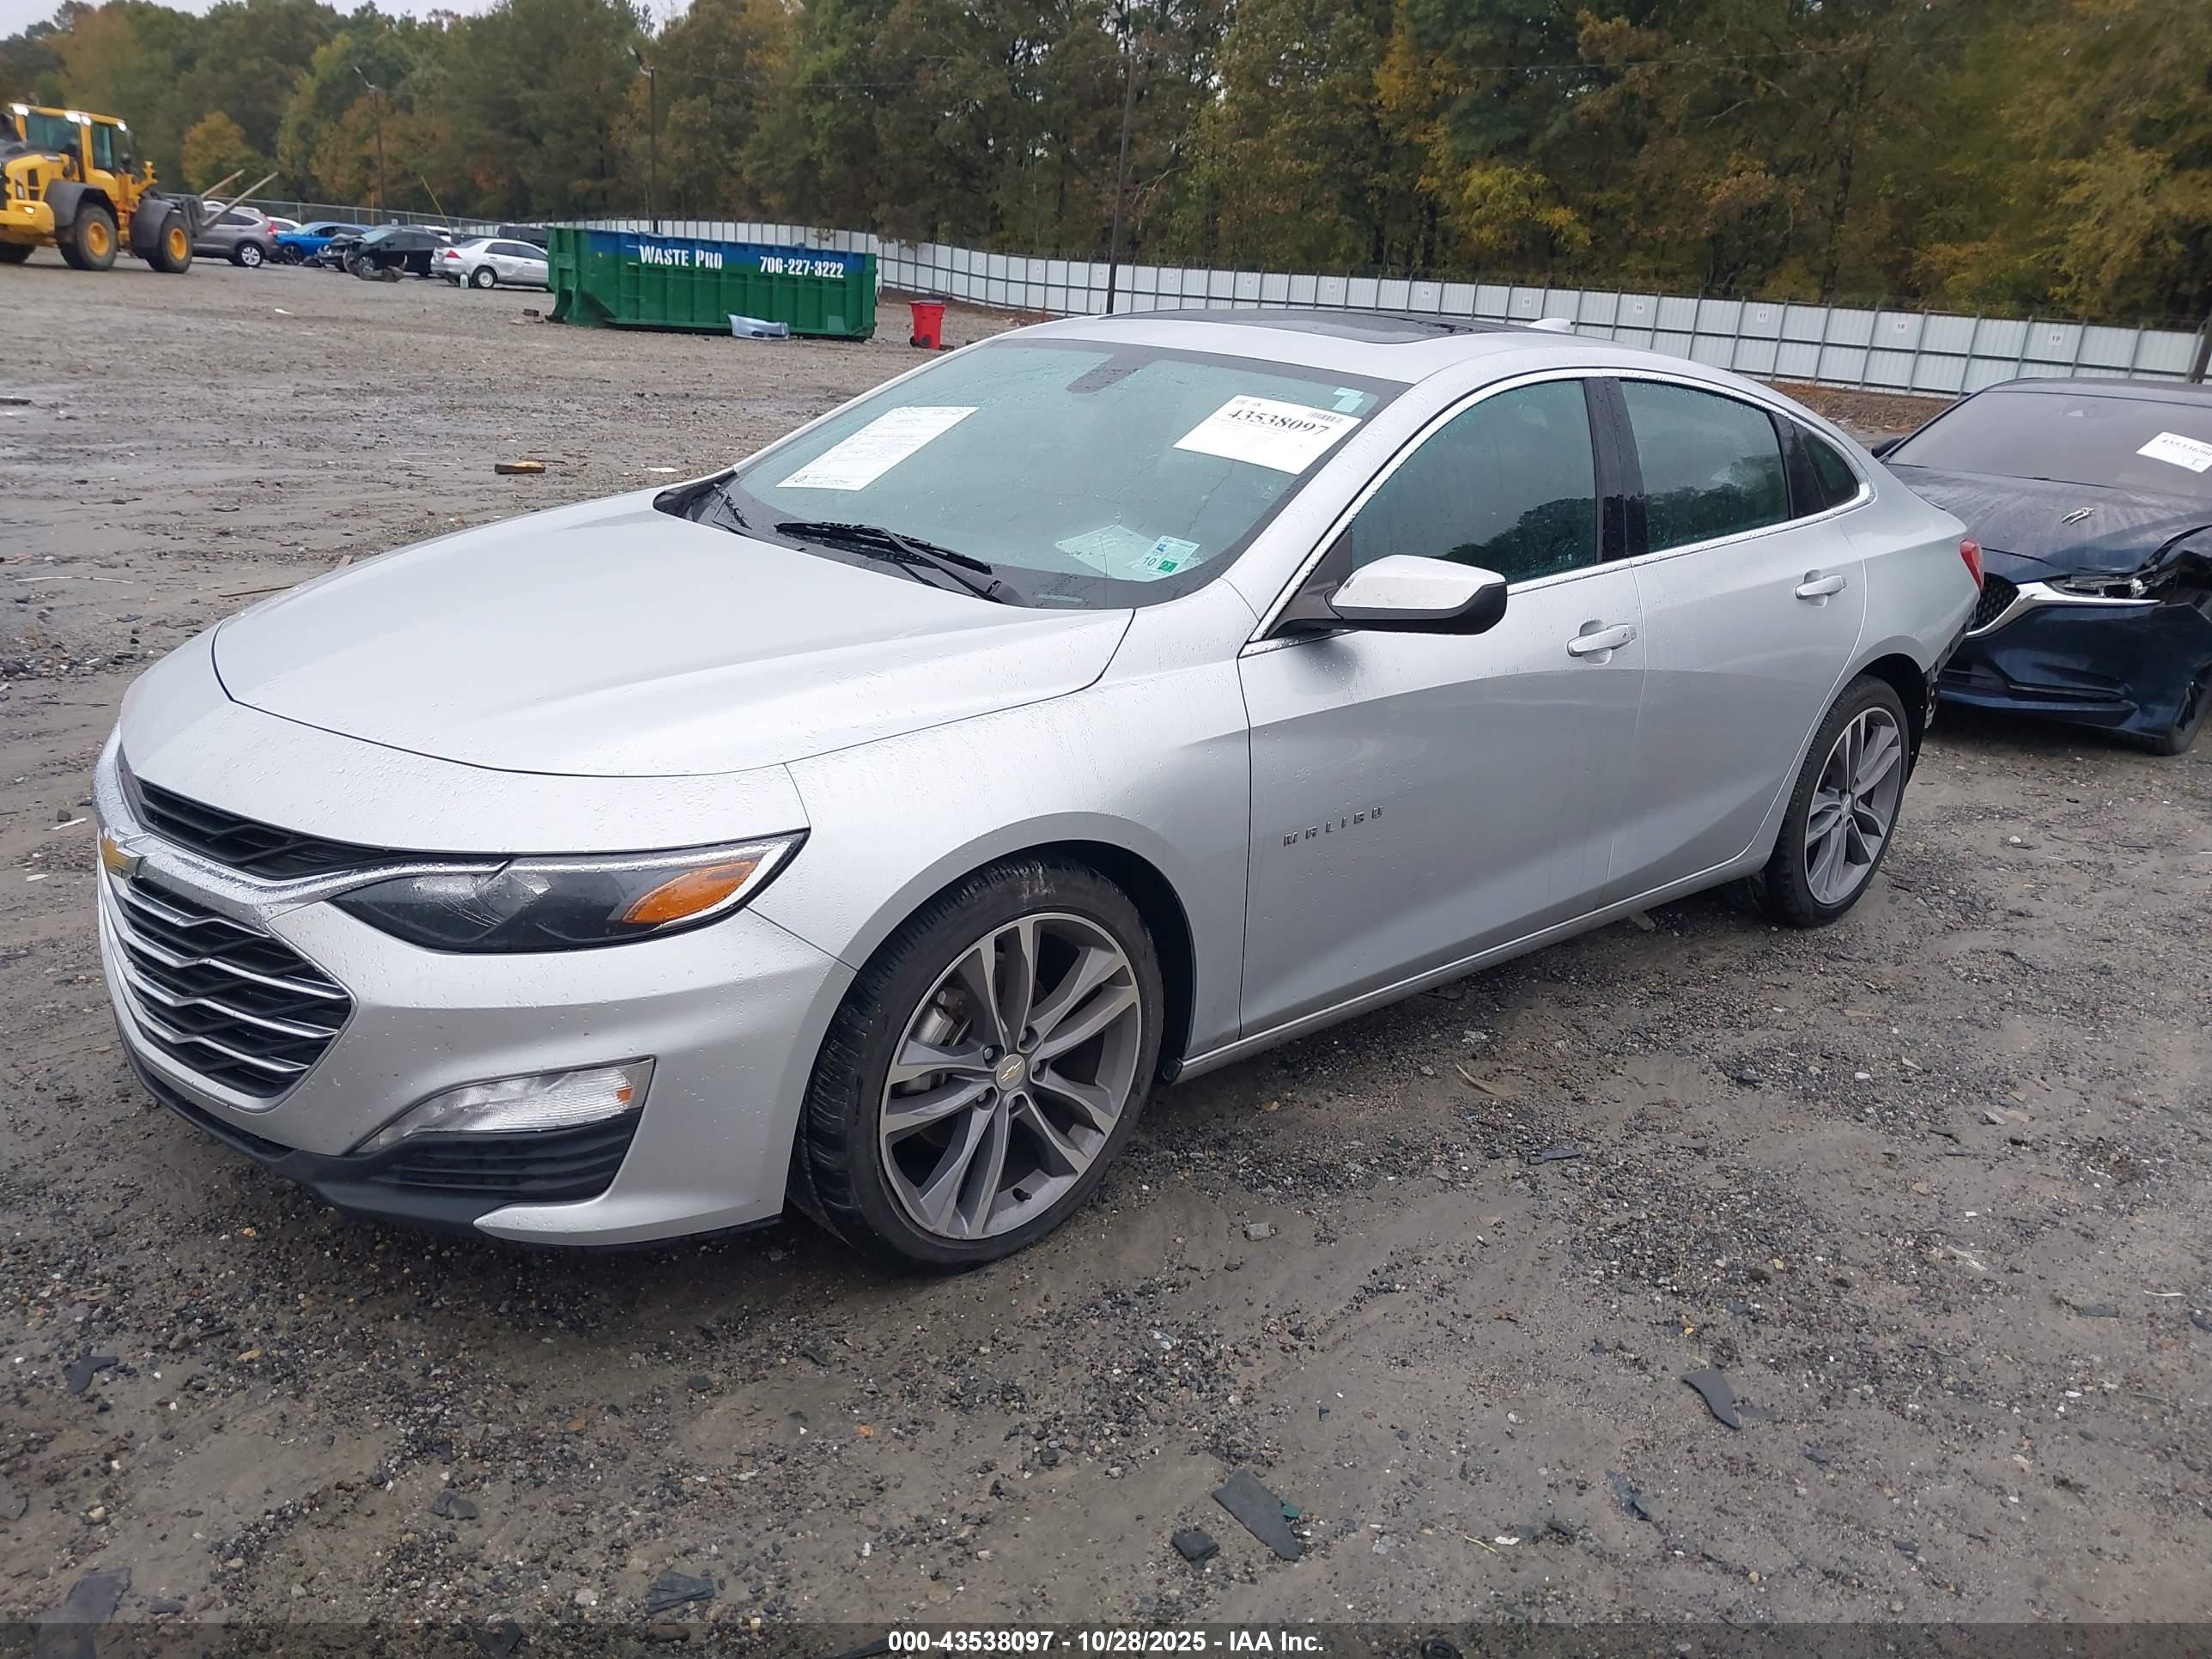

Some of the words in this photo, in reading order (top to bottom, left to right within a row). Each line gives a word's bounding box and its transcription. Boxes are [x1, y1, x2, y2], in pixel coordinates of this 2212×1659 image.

[639, 244, 690, 268] WASTE
[695, 248, 723, 270] PRO
[759, 255, 845, 279] 706-227-3222
[1228, 409, 1331, 435] 43538097
[1142, 556, 1158, 567] 10
[1283, 805, 1383, 847] MALIBU
